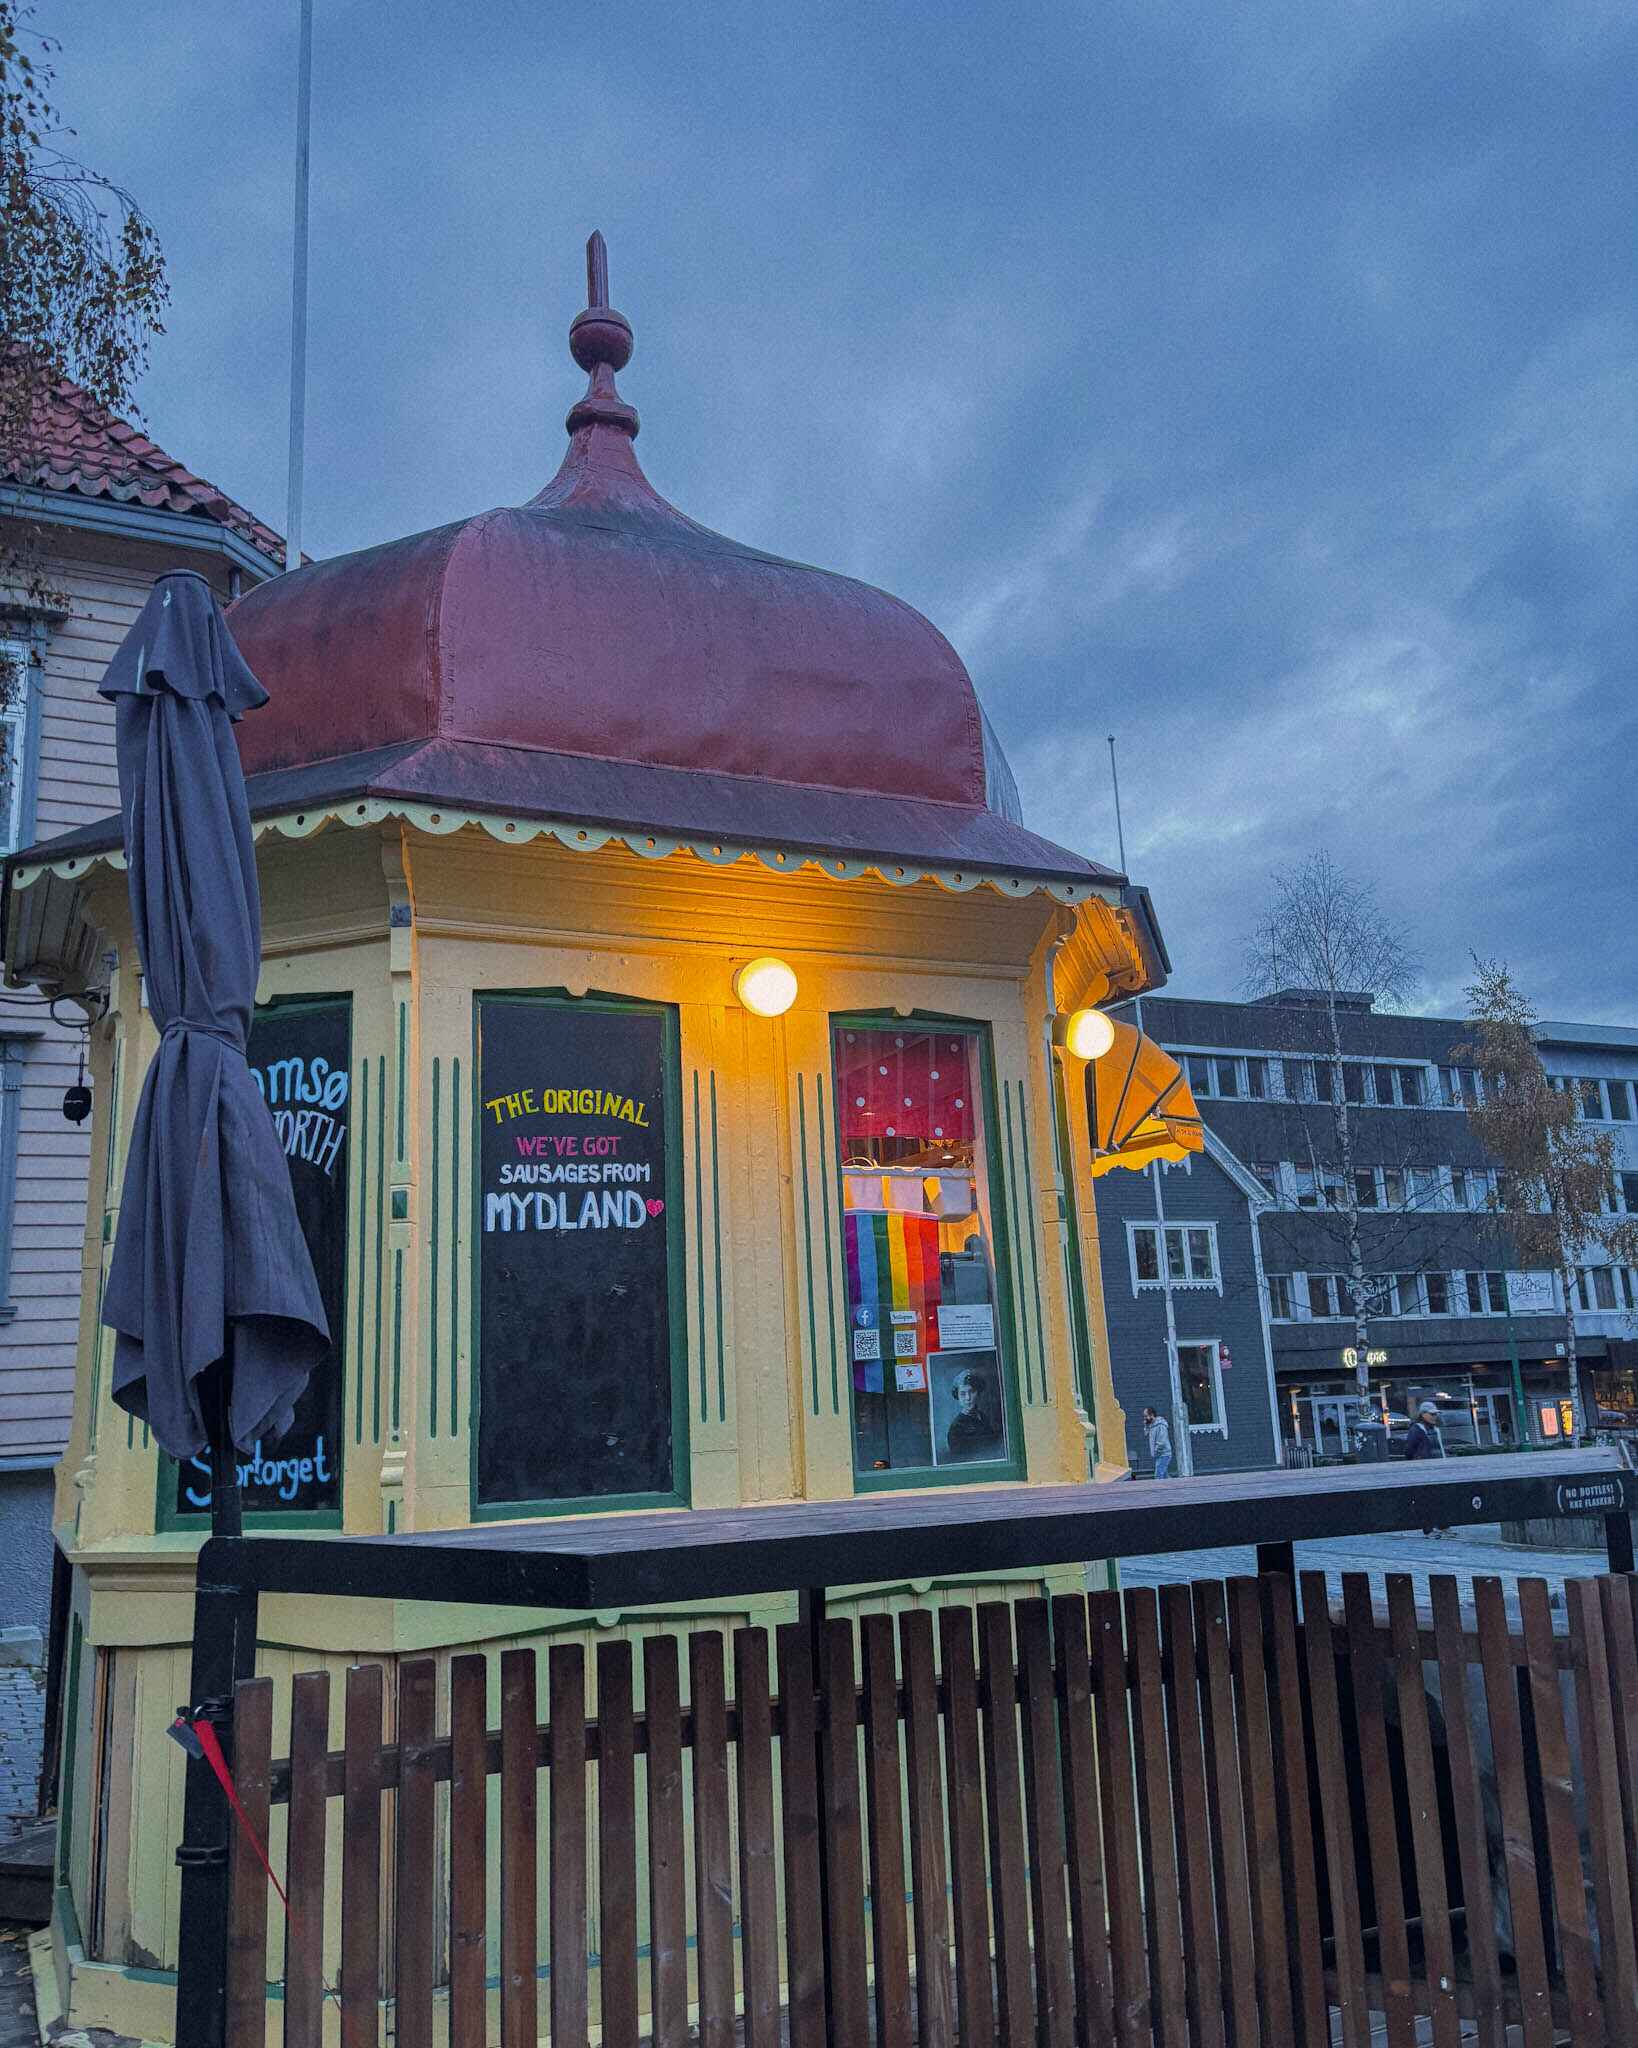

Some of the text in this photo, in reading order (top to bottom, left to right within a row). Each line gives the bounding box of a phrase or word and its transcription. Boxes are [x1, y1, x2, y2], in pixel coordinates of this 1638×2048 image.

[485, 1088, 650, 1128] THE ORIGINAL
[515, 1136, 622, 1157] WE'VE GOT
[500, 1162, 651, 1185] SAUSAGES FROM
[484, 1190, 648, 1232] MYDLAND
